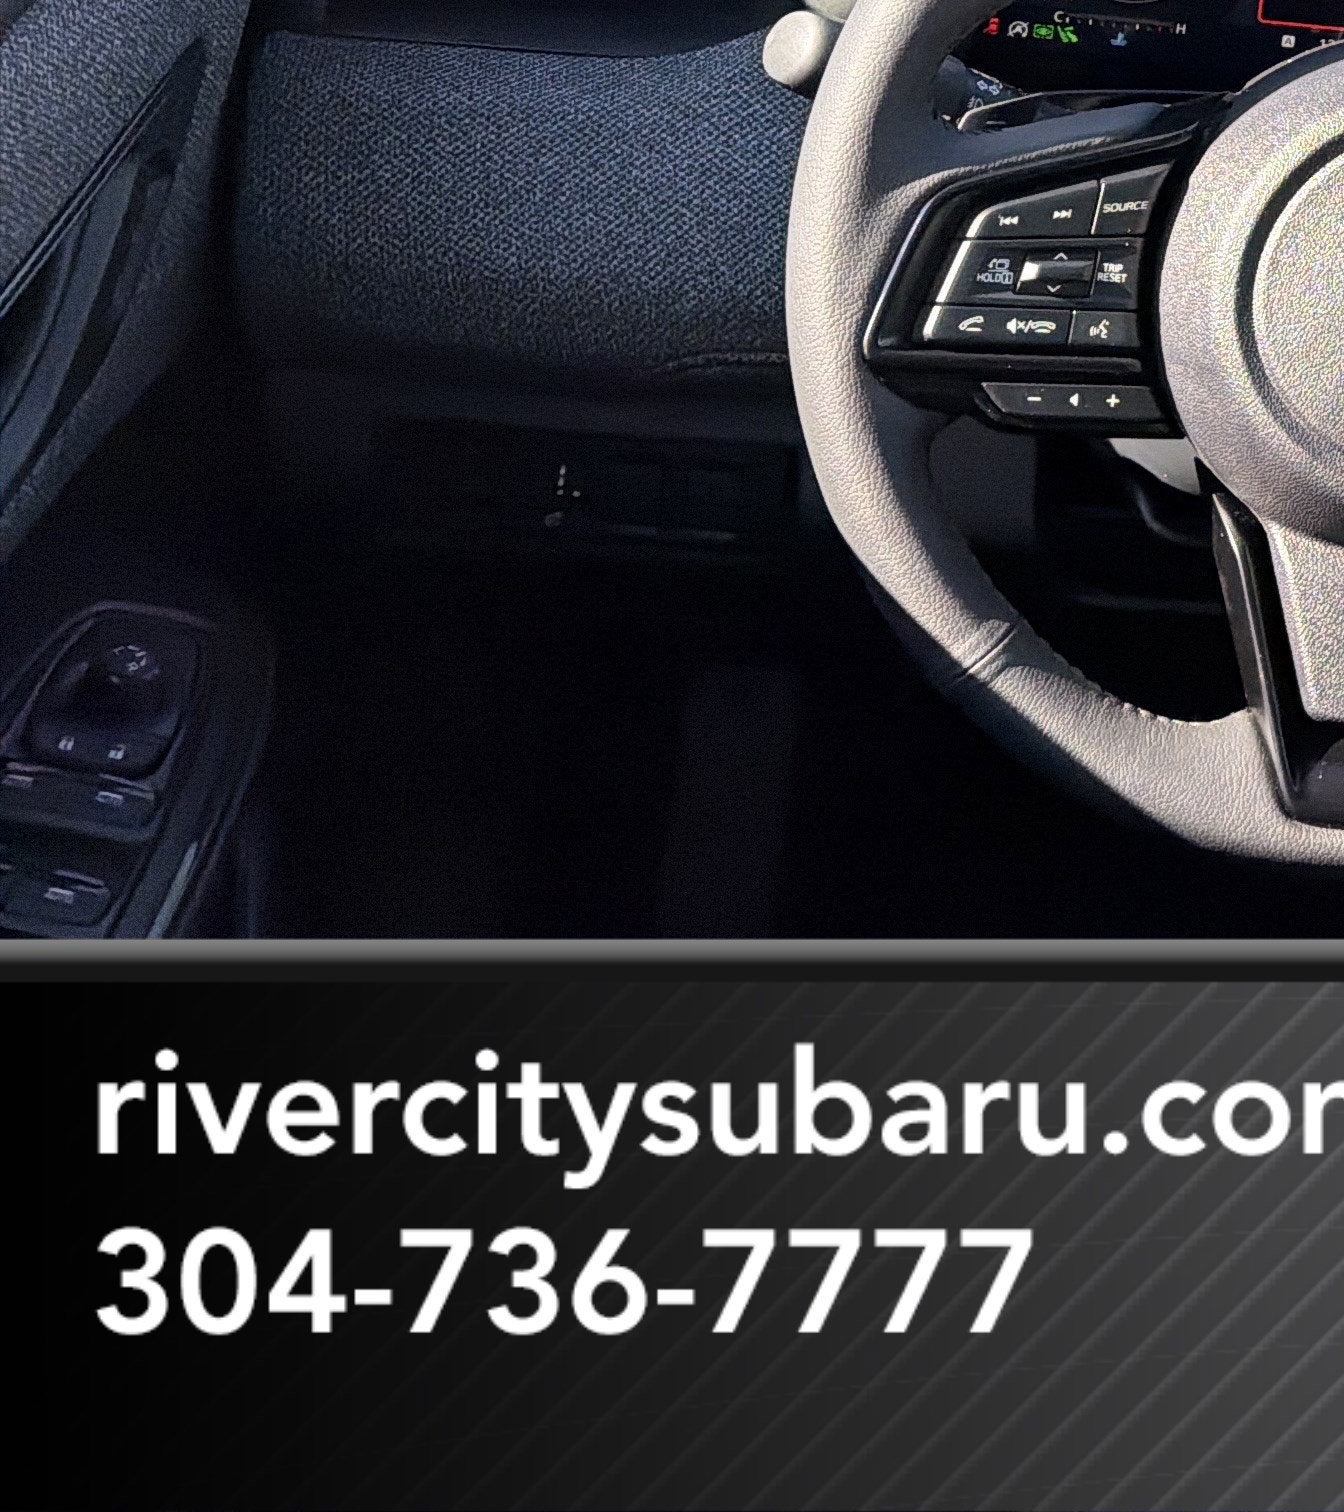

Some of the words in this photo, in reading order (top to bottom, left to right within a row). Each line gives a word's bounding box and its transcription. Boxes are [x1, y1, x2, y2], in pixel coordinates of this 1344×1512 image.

[1175, 23, 1187, 35] H
[1102, 199, 1150, 214] SOURCE
[1102, 262, 1124, 273] TRIP
[1097, 271, 1128, 284] RESET
